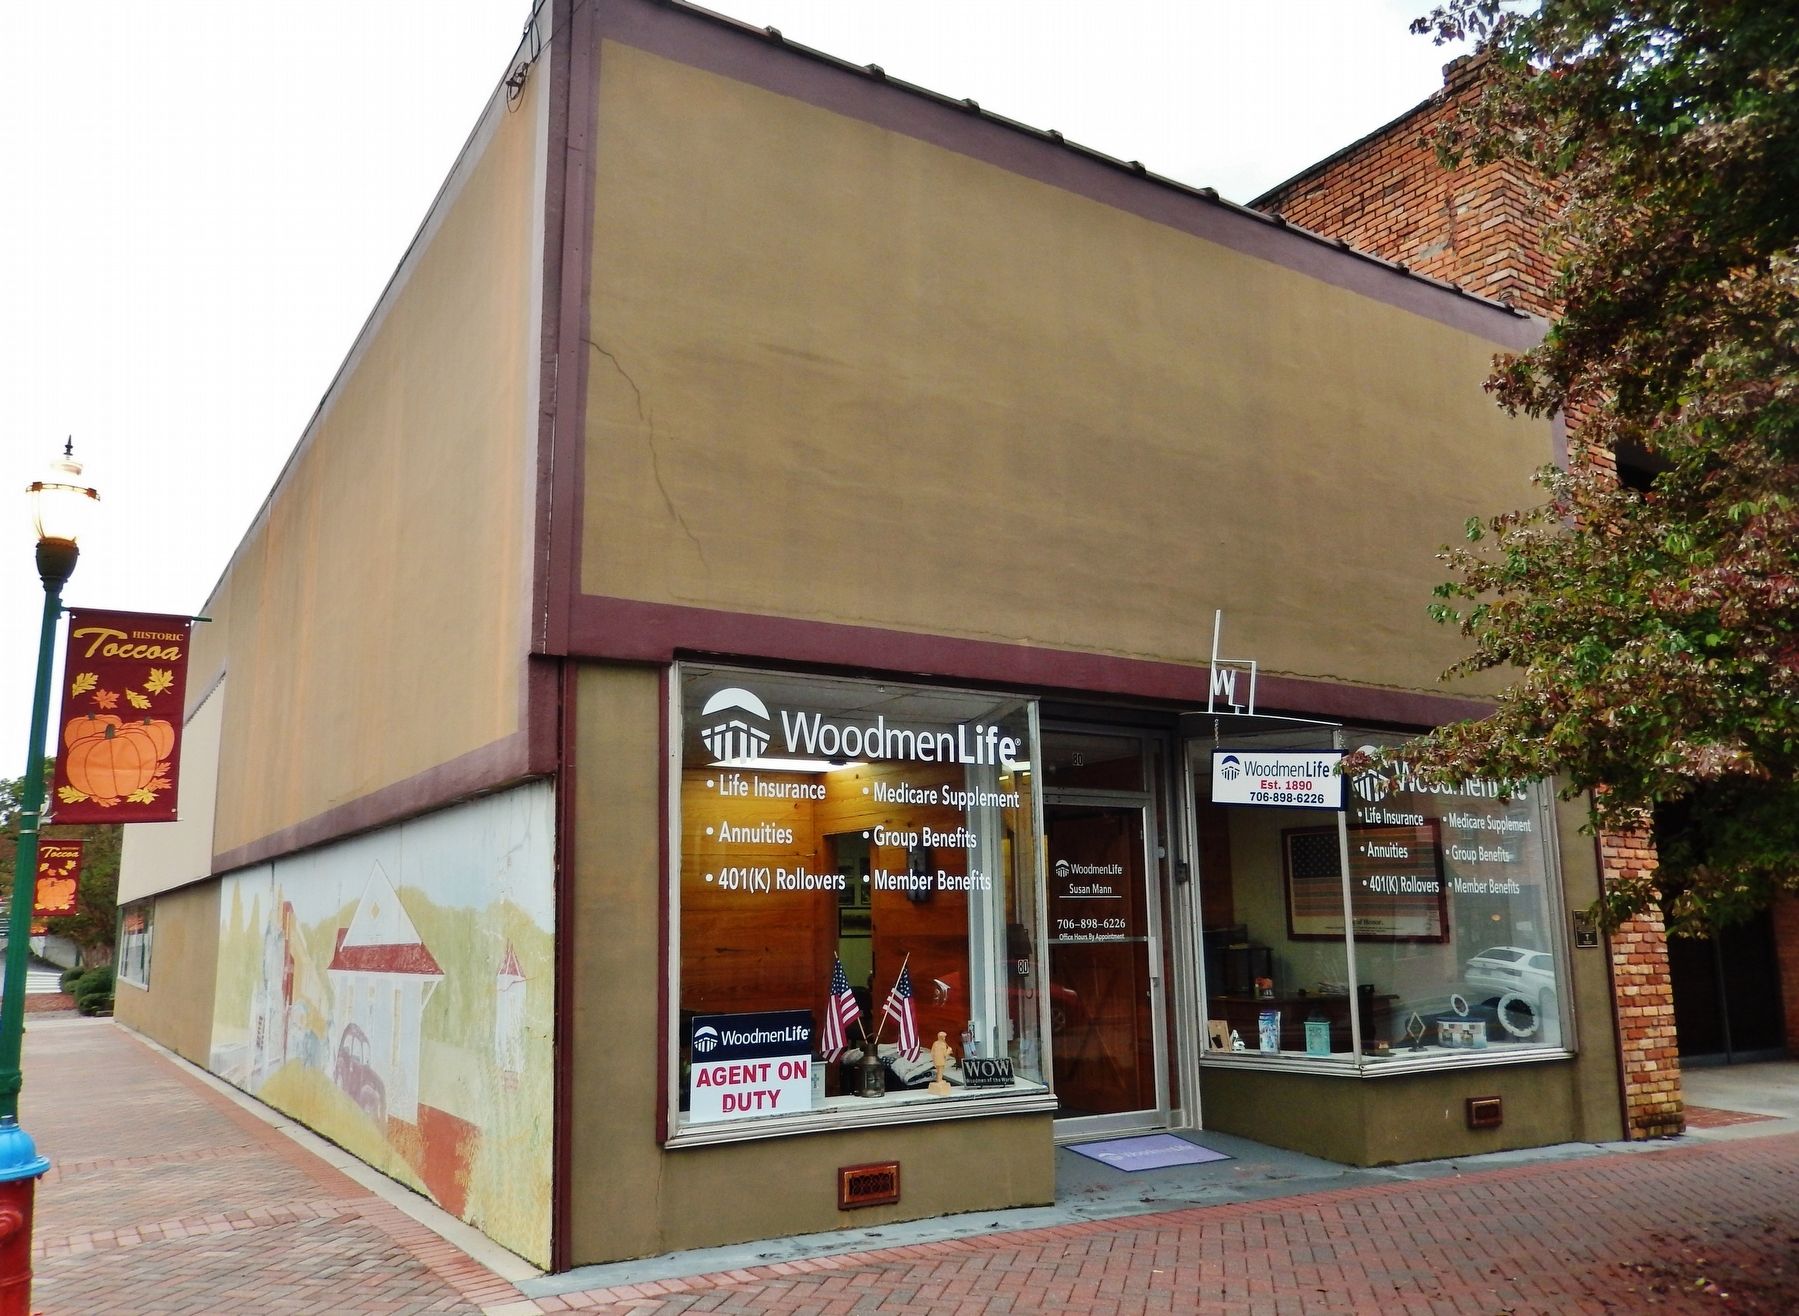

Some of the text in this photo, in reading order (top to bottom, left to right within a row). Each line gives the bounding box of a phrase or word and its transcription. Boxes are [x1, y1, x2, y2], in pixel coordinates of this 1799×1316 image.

[73, 627, 183, 662] Toccoa
[132, 630, 184, 642] HISTORIC
[1244, 760, 1330, 778] WoodmenLife
[719, 774, 826, 800] Life Insurance
[1260, 780, 1313, 791] Est. 1890
[874, 782, 1020, 811] Medicare Supplement
[1365, 808, 1424, 826] Life Insurance
[1449, 812, 1532, 834] Medicare Supplement
[718, 821, 793, 845] Annuities
[874, 825, 977, 852] Group Benefits
[1367, 841, 1408, 859] Annuities
[1451, 845, 1510, 864] Group Benefits
[1071, 863, 1123, 875] WoodmenLife
[718, 868, 846, 894] 401(K) Rollovers
[874, 869, 991, 892] Member Benefits
[1069, 883, 1112, 894] Susan Mann
[1369, 875, 1440, 895] 401(K) Rollovers
[1454, 877, 1520, 894] Member Benefits
[1057, 918, 1126, 929] 706-898-6226
[721, 1025, 809, 1047] WoodmenLife
[696, 1060, 808, 1088] AGENT ON
[964, 1060, 1010, 1077] WOW
[722, 1089, 781, 1113] DUTY
